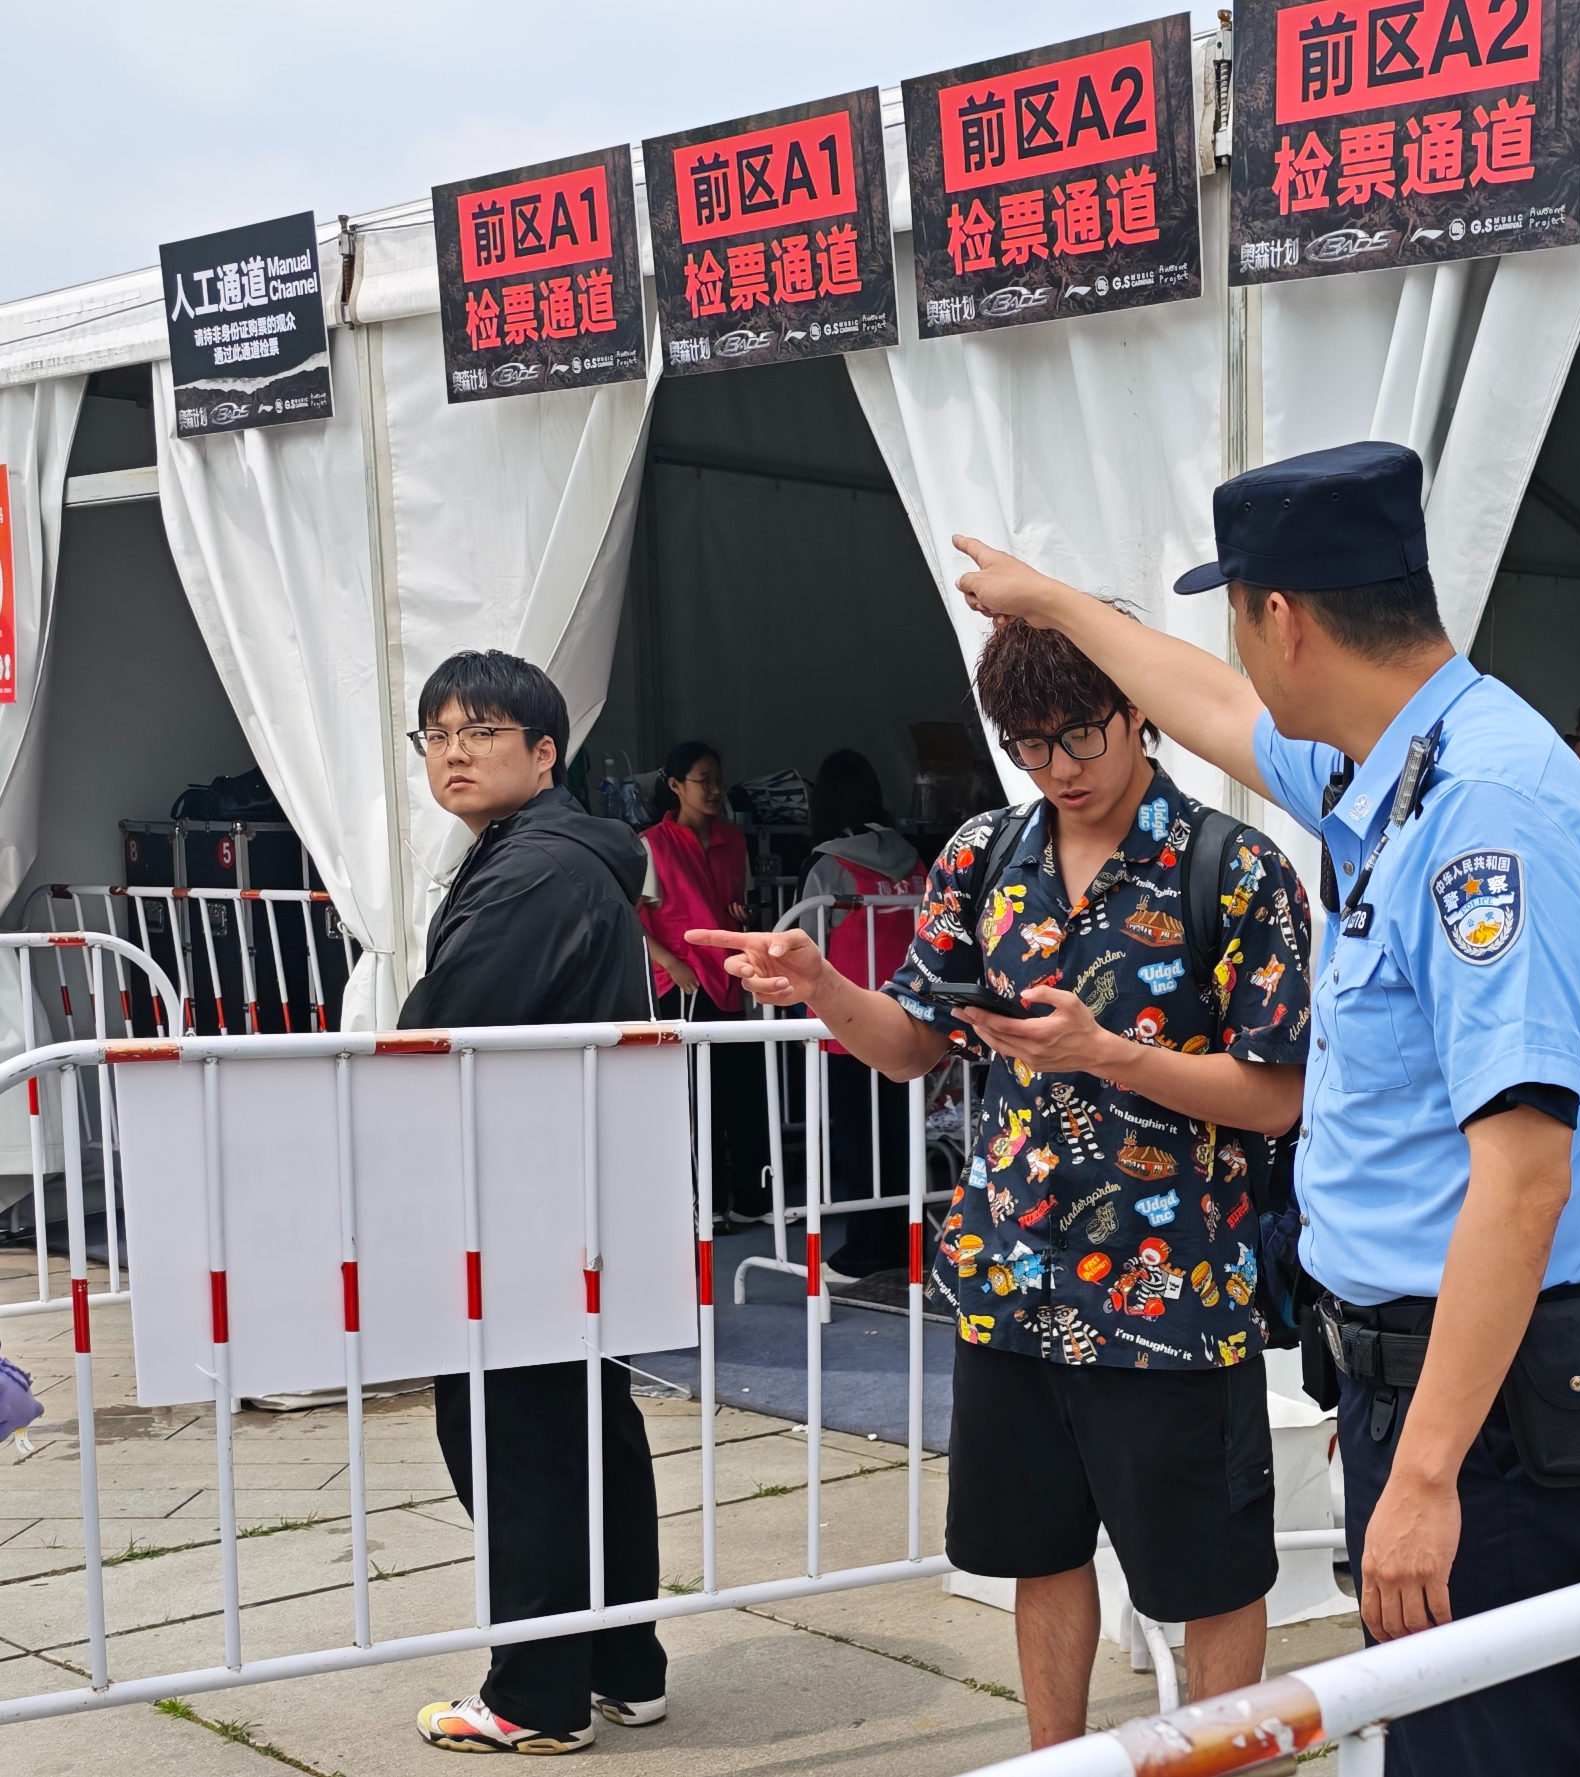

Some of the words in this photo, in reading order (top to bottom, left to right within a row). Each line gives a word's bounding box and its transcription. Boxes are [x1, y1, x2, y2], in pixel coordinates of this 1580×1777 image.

[1298, 0, 1530, 103] 前区A2
[958, 66, 1147, 173] 前区A2
[1272, 94, 1537, 216] 检票通道
[690, 134, 841, 226] 前区A1
[471, 186, 599, 267] 前区A1
[947, 164, 1160, 276] 检票通道
[1493, 214, 1524, 225] MUSIC
[267, 249, 312, 278] Manual
[684, 223, 862, 319] 检票通道
[1240, 238, 1299, 273] 奥森计划
[171, 255, 268, 322] 人工通道
[269, 272, 318, 301] Channel
[465, 267, 617, 352] 检票通道
[927, 294, 975, 328] 奥森计划
[194, 311, 297, 347] 请持非身份证购票的观众
[214, 337, 280, 365] 通过此通道检票
[669, 337, 711, 365] 奥森计划
[130, 840, 138, 862] 8
[222, 841, 232, 864] 5
[1435, 855, 1511, 895] 中华人民共和国
[1461, 896, 1494, 915] POLICE
[1072, 950, 1126, 995] ndergarden
[1140, 962, 1182, 981] Udgd
[1153, 979, 1174, 992] inc
[1169, 1124, 1178, 1135] it
[1060, 1181, 1121, 1232] Undergarden
[1136, 1192, 1177, 1214] Udgd
[1150, 1211, 1173, 1225] inc
[1182, 1350, 1193, 1361] it
